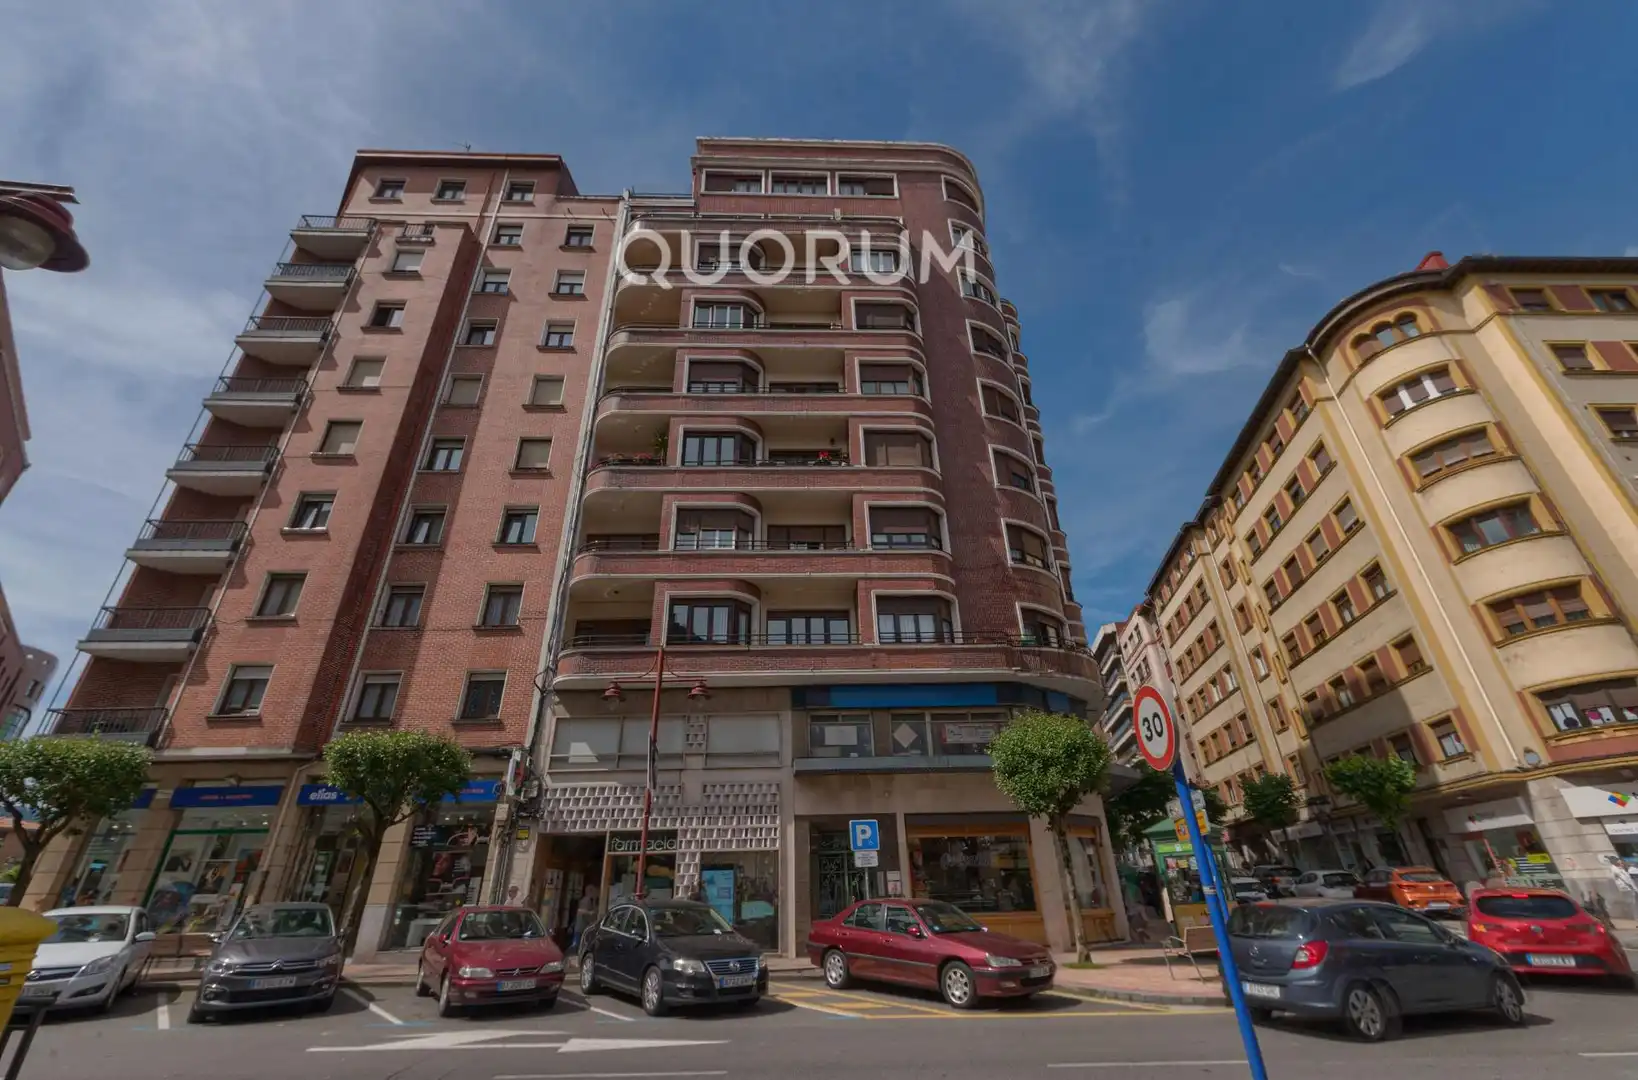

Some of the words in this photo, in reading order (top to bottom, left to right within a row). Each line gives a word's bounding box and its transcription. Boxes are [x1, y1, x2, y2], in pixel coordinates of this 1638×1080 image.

[1142, 712, 1164, 742] 30
[611, 835, 677, 851] farmacia
[855, 824, 872, 847] P
